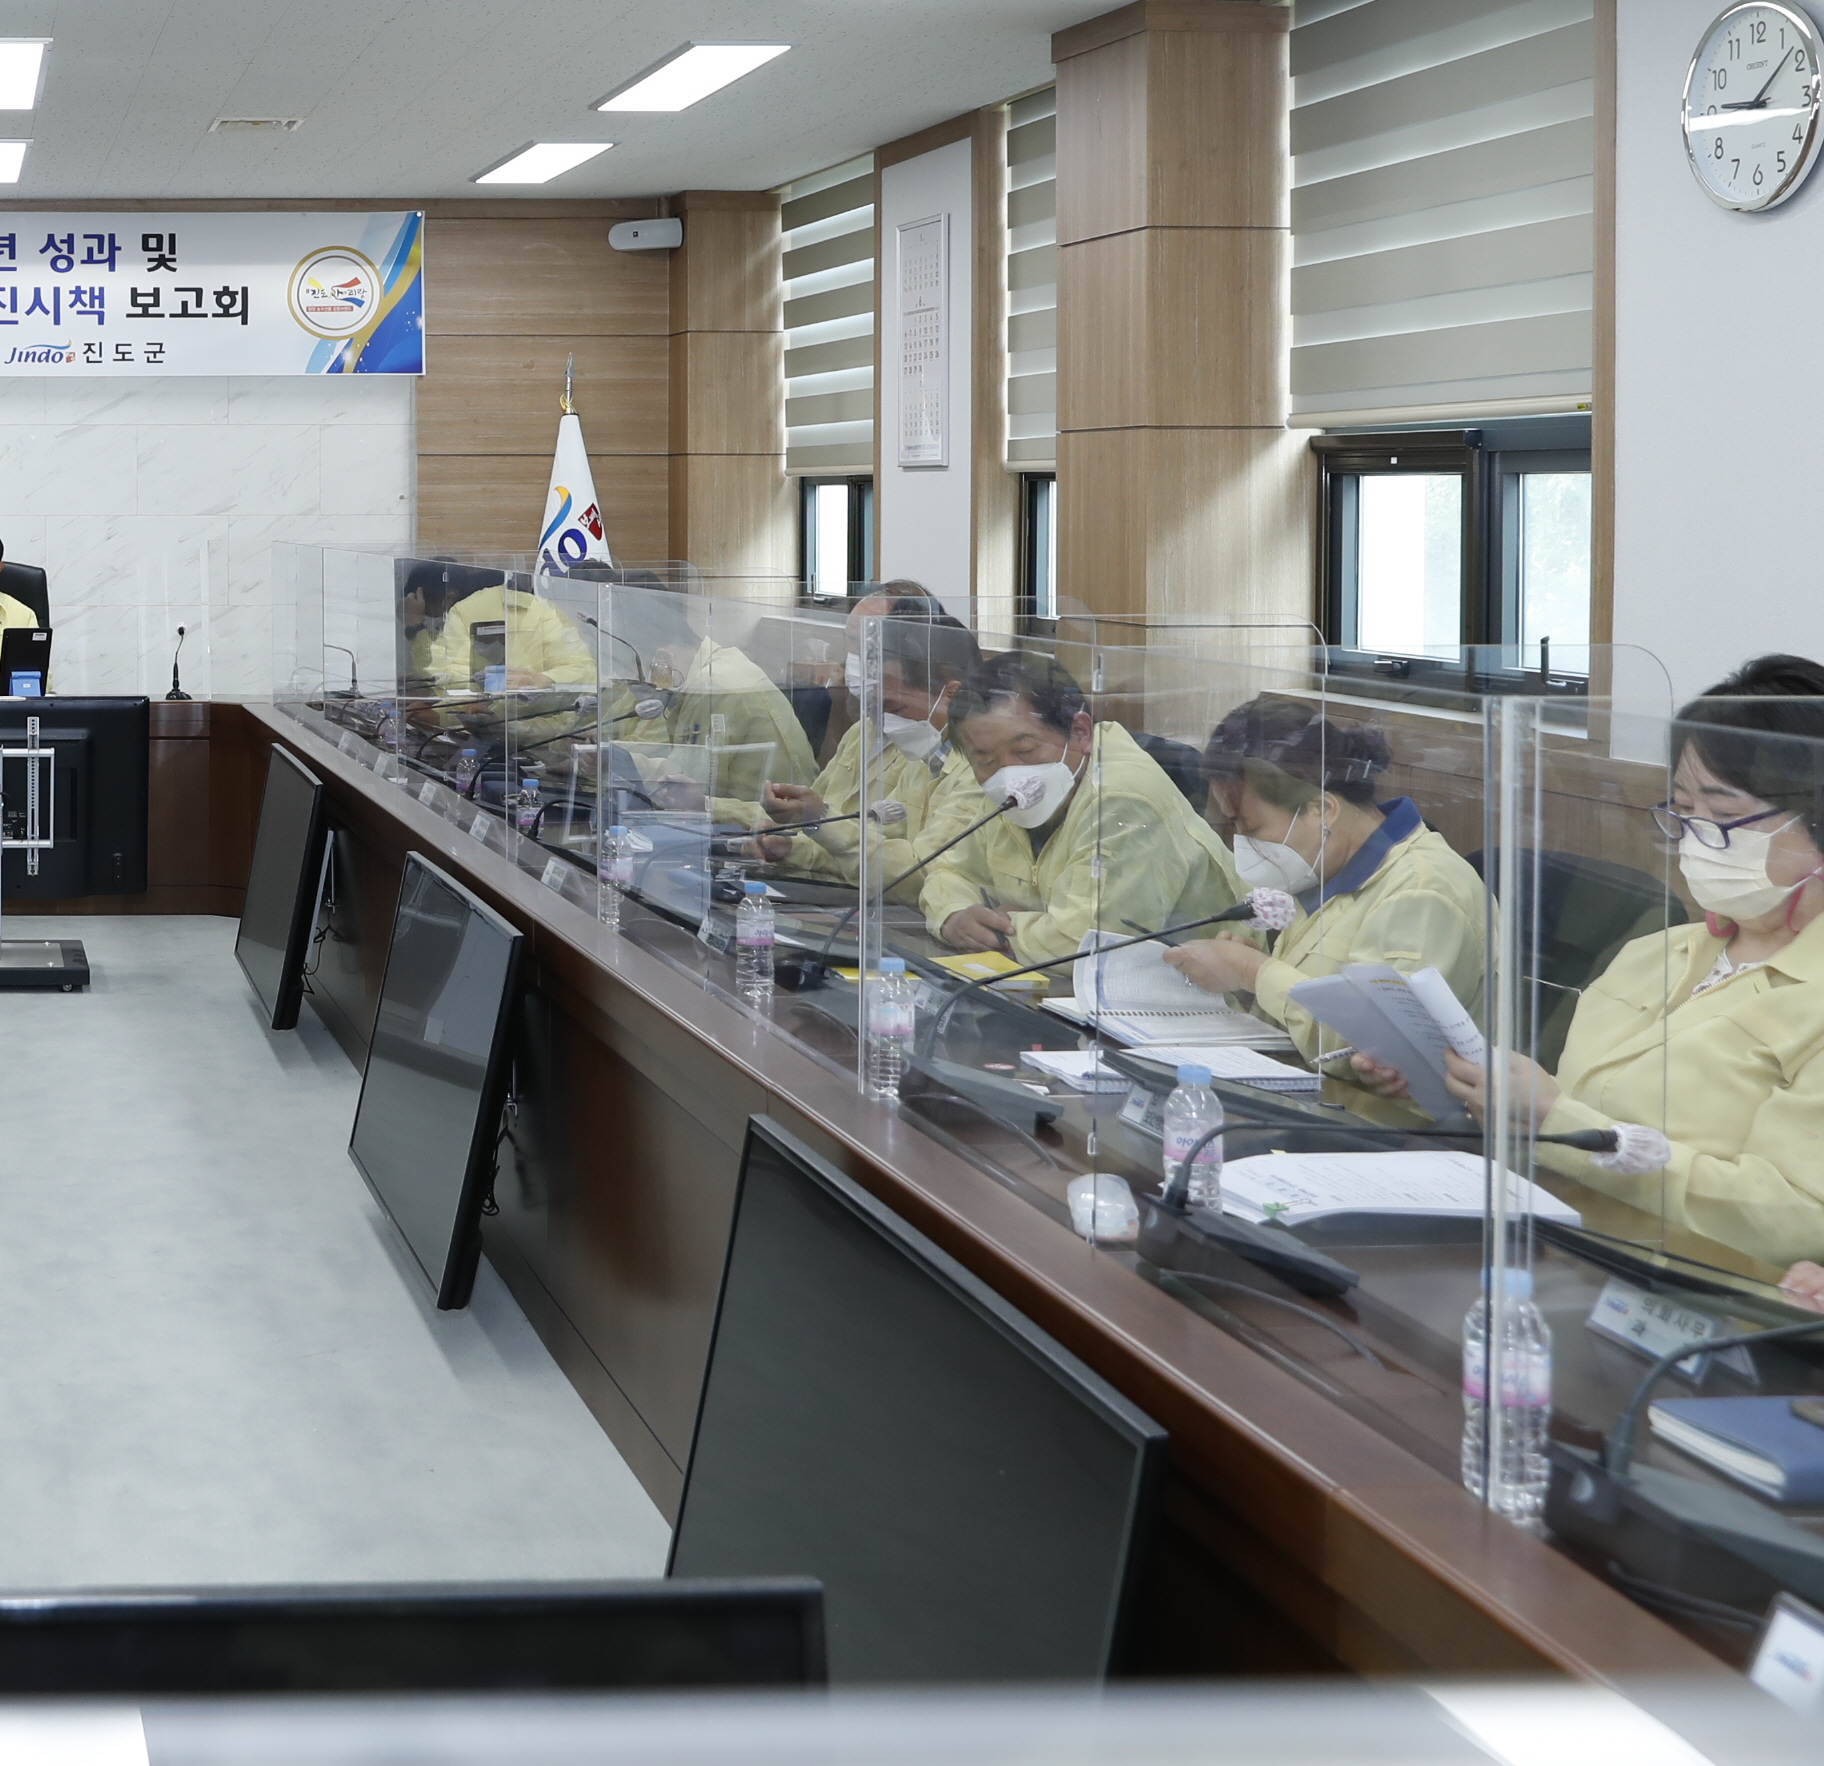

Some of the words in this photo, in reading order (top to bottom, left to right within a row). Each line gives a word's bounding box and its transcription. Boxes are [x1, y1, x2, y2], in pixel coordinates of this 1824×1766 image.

[1749, 21, 1766, 44] 12
[1779, 28, 1785, 49] 1
[1728, 38, 1740, 61] 11
[1794, 49, 1805, 72] 2
[1712, 68, 1727, 90] 10
[1801, 85, 1811, 107] 3
[1792, 123, 1804, 144] 4
[1714, 137, 1724, 160] 8
[1731, 158, 1740, 180] 7
[1776, 151, 1786, 173] 5
[1752, 163, 1764, 186] 6
[39, 233, 122, 273] 성과
[141, 233, 178, 273] 및
[126, 286, 249, 325] 보고회
